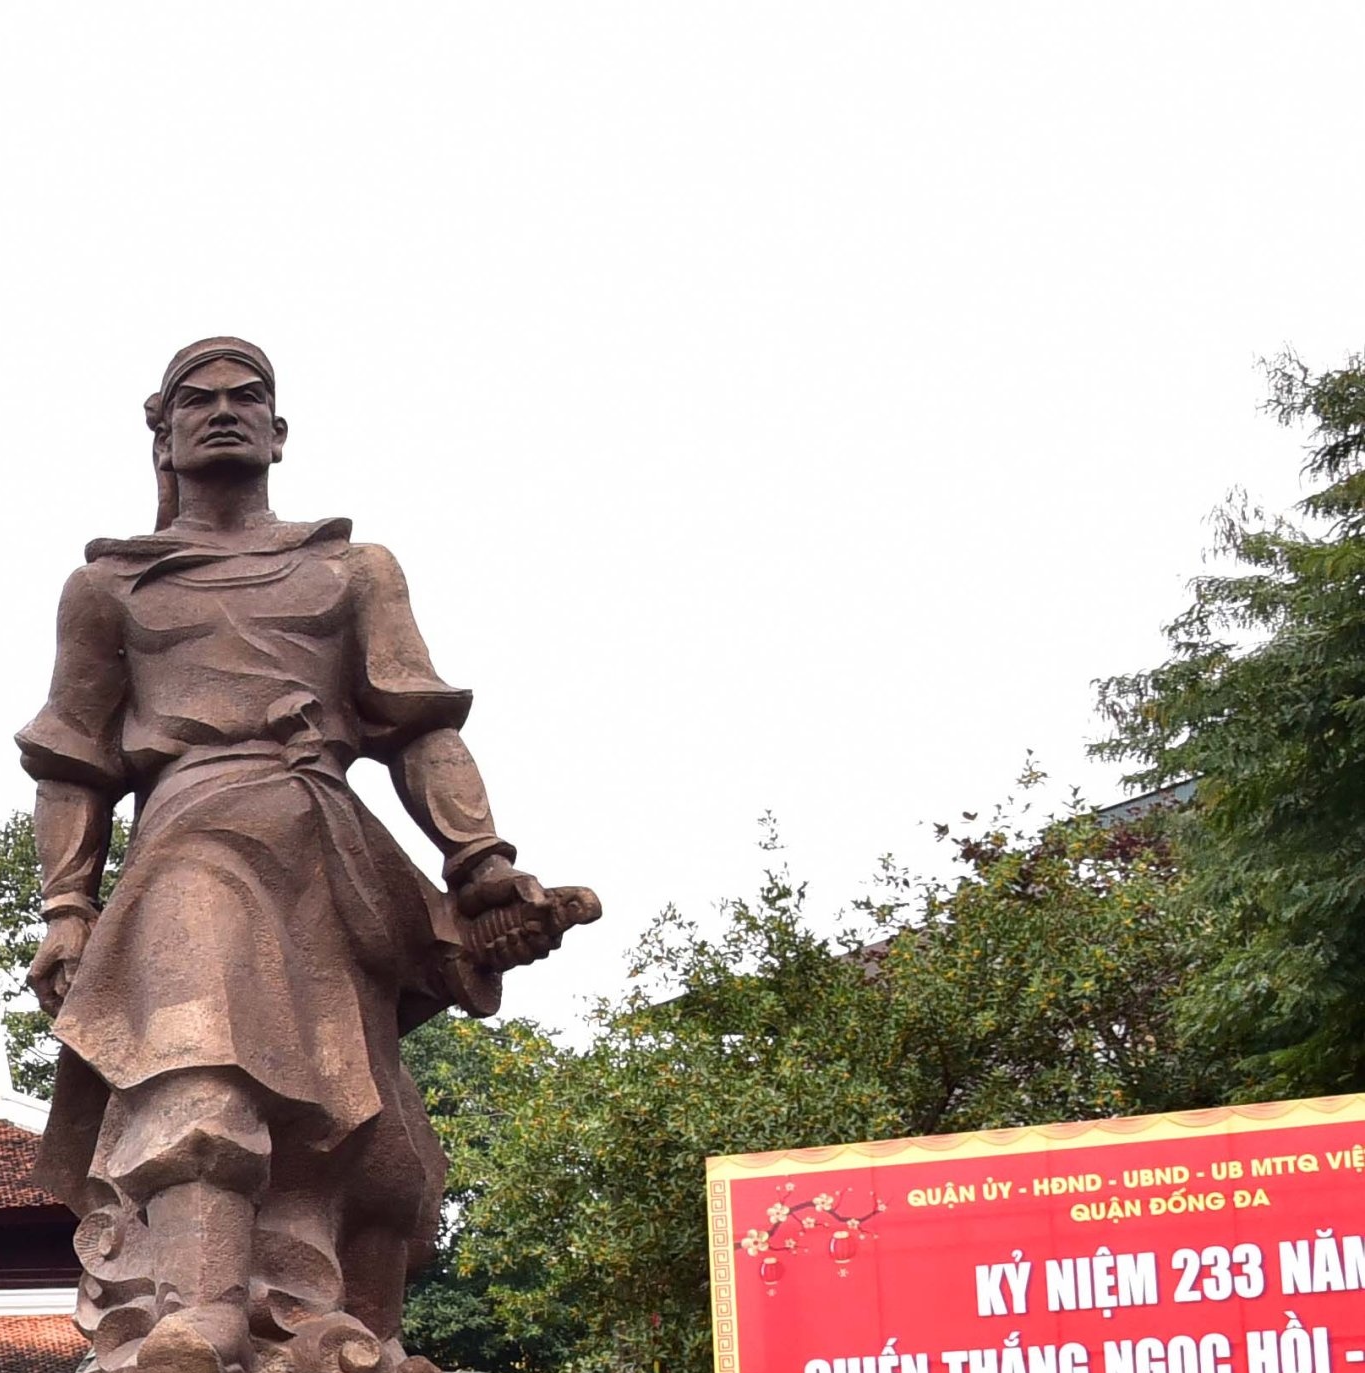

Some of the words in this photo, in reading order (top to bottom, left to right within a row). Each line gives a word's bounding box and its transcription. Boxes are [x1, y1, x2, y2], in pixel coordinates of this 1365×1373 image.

[907, 1182, 976, 1208] QUẬN
[982, 1176, 1013, 1201] ỦY
[1033, 1173, 1103, 1196] HĐND
[1123, 1165, 1190, 1189] UBND
[1211, 1160, 1244, 1181] UB
[1250, 1153, 1320, 1177] MTTQ
[1325, 1144, 1365, 1173] VIỆ
[1070, 1197, 1142, 1224] QUẬN
[1149, 1188, 1226, 1216] ĐỐNG
[1233, 1188, 1271, 1208] ĐA
[975, 1249, 1031, 1317] KỶ
[1045, 1246, 1158, 1318] NIỆM
[1171, 1243, 1264, 1303] 233
